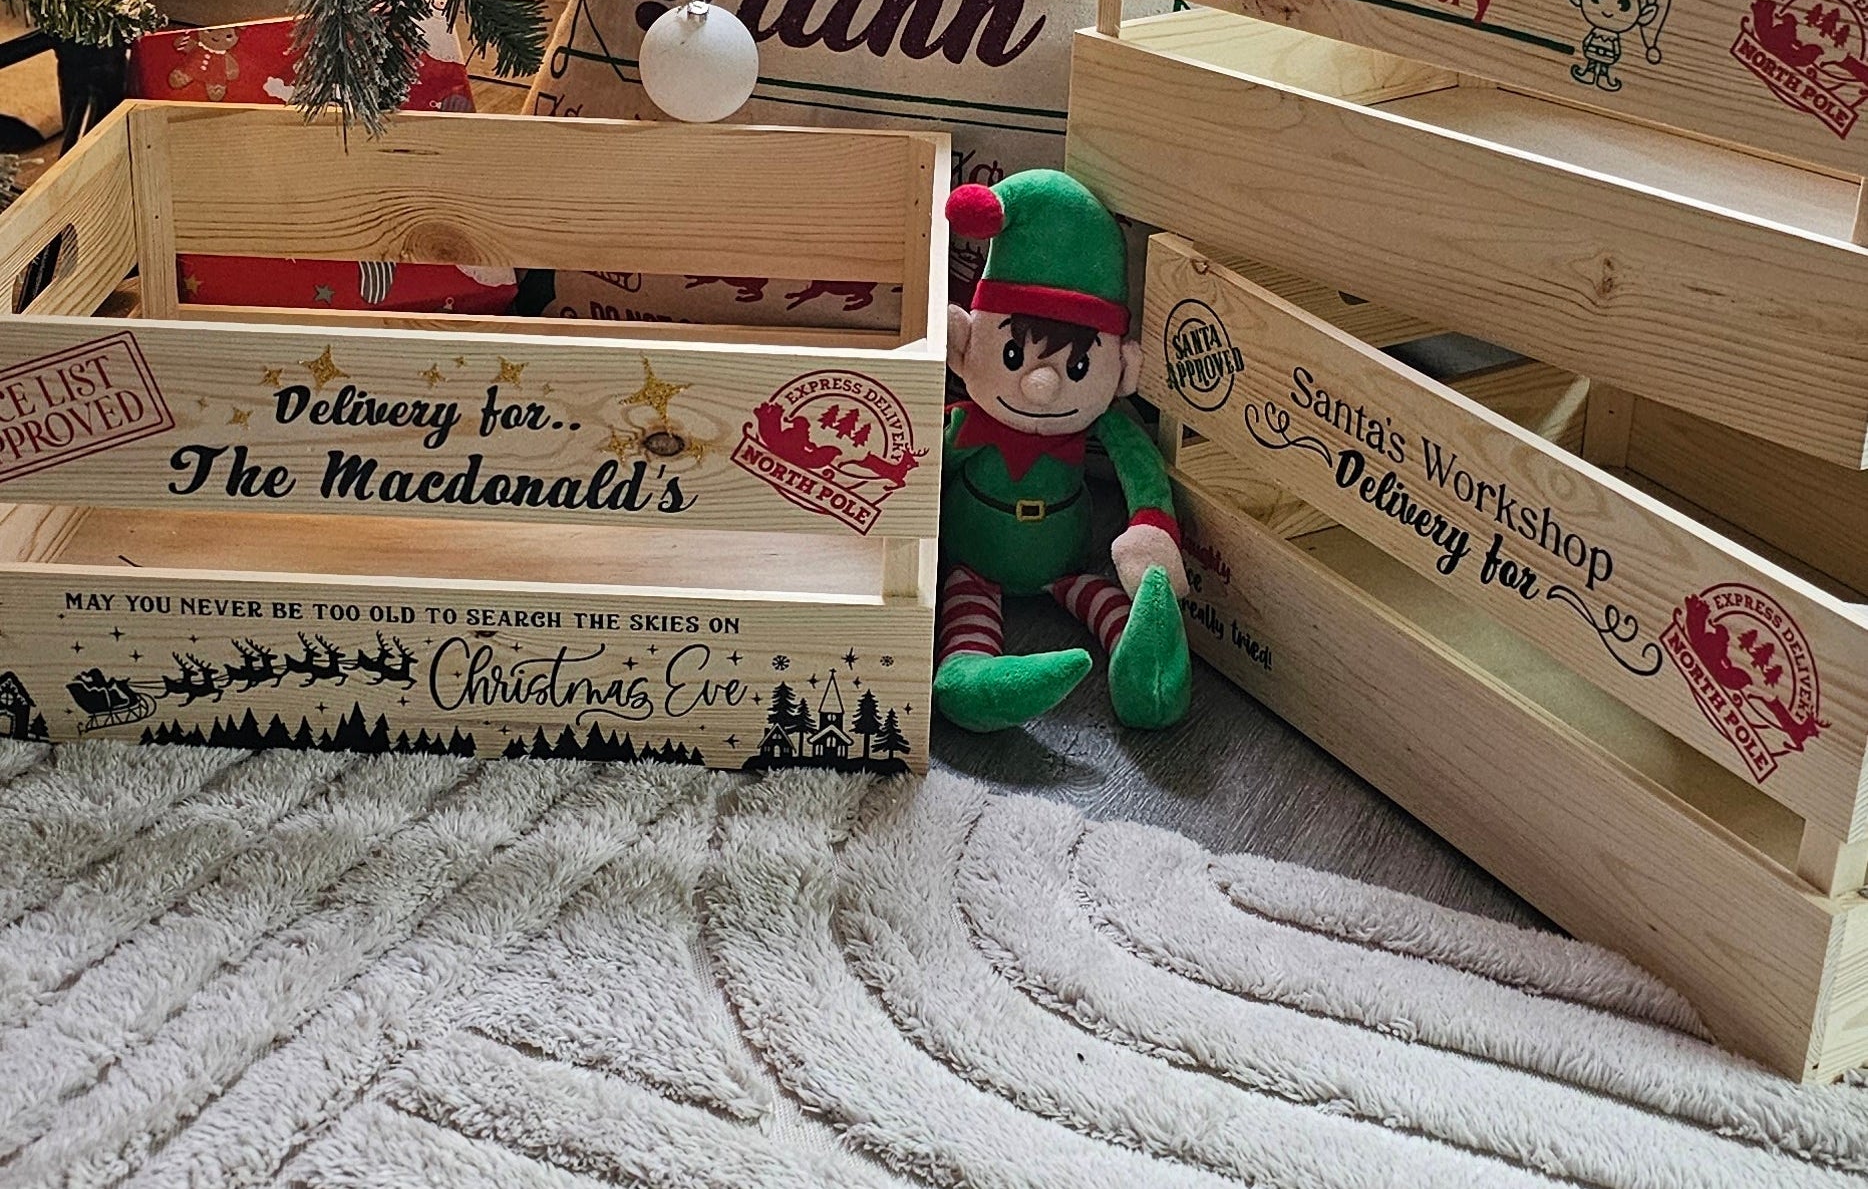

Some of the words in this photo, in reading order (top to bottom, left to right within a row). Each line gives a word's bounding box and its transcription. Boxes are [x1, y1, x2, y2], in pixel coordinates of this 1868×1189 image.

[1738, 39, 1802, 93] NORTH
[1800, 85, 1849, 128] POLE
[1166, 347, 1244, 390] APPROVED
[1172, 324, 1222, 360] SANTA
[35, 355, 113, 408] LIST
[273, 385, 461, 449] Delivery
[784, 378, 863, 405] EXPRESS
[863, 389, 906, 462] DELIVERY
[0, 390, 144, 464] PROVED
[168, 444, 297, 498] The
[320, 450, 699, 513] Macdonald's
[741, 445, 818, 495] NORTH
[815, 486, 871, 525] POLE
[1290, 367, 1406, 463] Santa's
[1422, 436, 1614, 590] Workshop
[1334, 450, 1471, 575] Delivery
[1479, 533, 1539, 600] for
[65, 592, 115, 610] MAY
[125, 595, 171, 613] YOU
[181, 598, 263, 618] NEVER
[272, 602, 303, 619] BE
[313, 603, 360, 622] TOO
[370, 605, 415, 624] OLD
[425, 608, 457, 625] TO
[467, 609, 561, 628] SEARCH
[573, 612, 620, 630] THE
[629, 614, 700, 633] SKIES
[709, 617, 740, 634] ON
[1181, 597, 1224, 640] really
[1231, 619, 1272, 671] tried!
[429, 636, 654, 726] Christmas
[664, 643, 748, 717] Eve
[1713, 593, 1783, 629] EXPRESS
[1782, 628, 1813, 721] DELIVERY
[1668, 632, 1727, 707] NORTH
[1723, 711, 1769, 771] POLE
